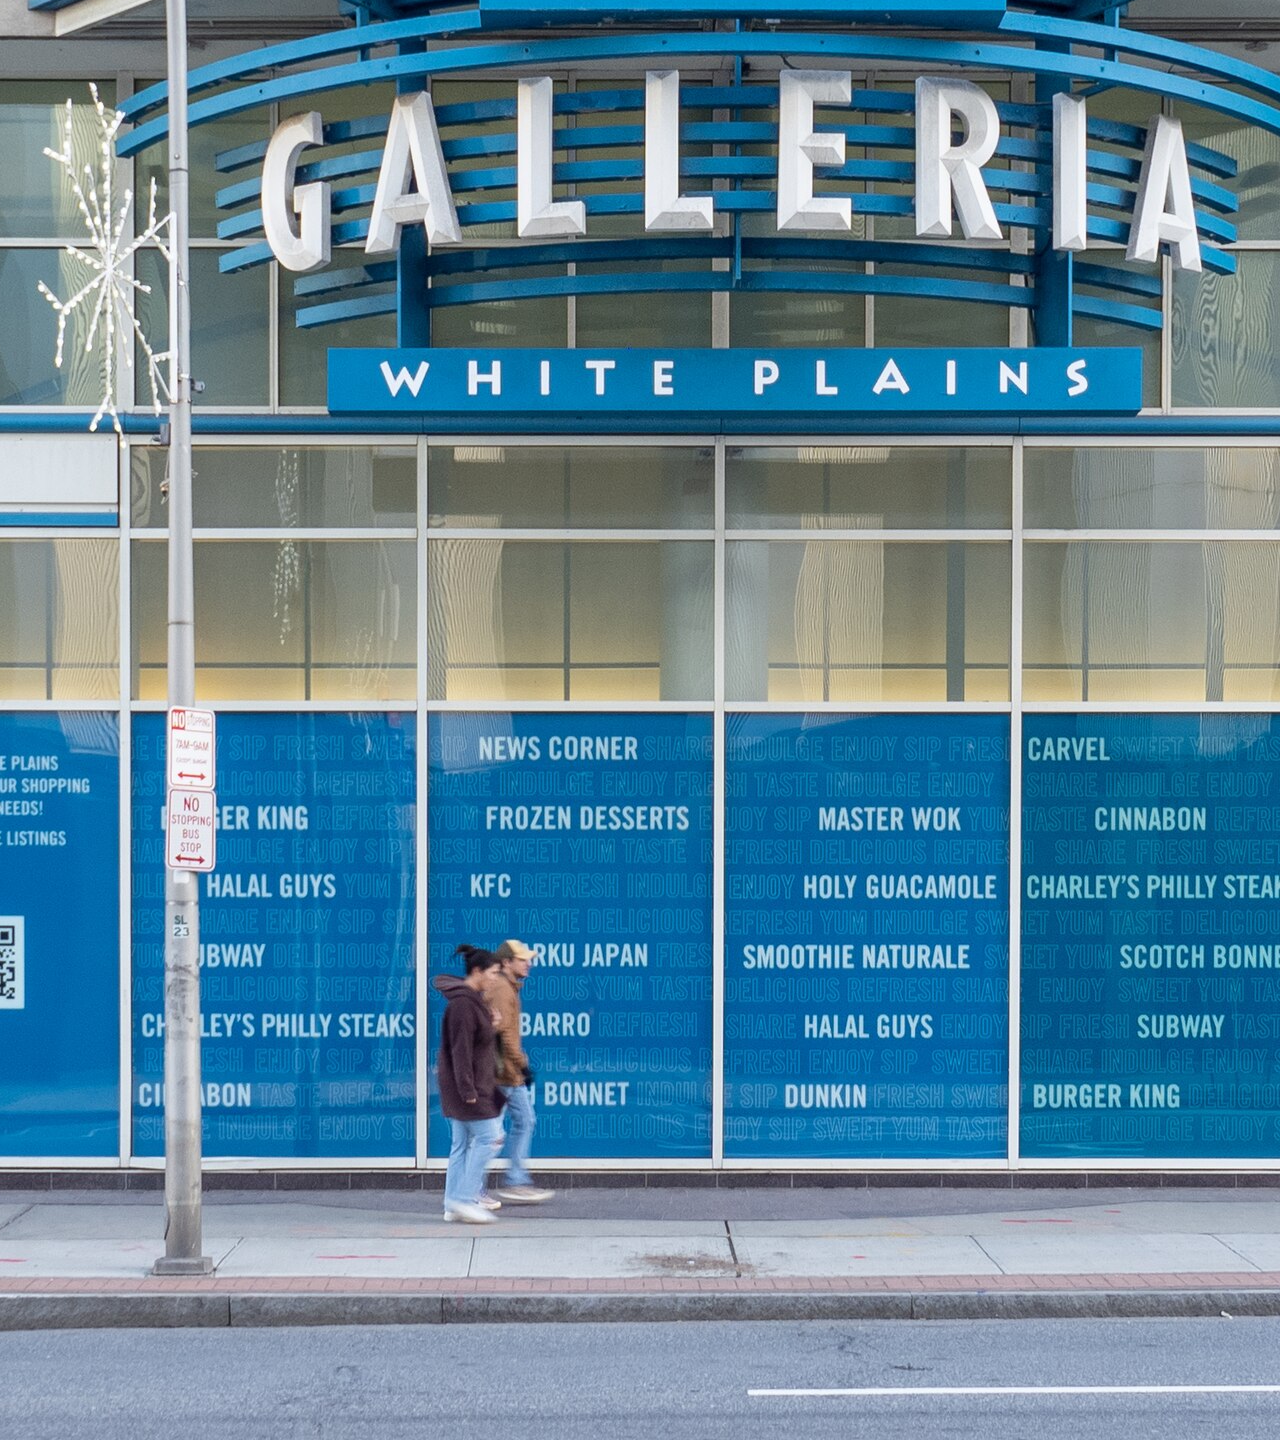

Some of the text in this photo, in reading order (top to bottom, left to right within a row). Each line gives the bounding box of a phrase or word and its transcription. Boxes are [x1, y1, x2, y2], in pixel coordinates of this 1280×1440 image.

[262, 69, 1202, 273] GALLERIA
[379, 359, 1089, 397] WHITE PLAINS
[173, 712, 185, 728] NO
[229, 735, 343, 760] SIP FRESH
[478, 736, 637, 761] NEWS CORNER
[832, 736, 941, 761] ENJOY SIP
[1029, 737, 1110, 761] CARVEL
[11, 755, 58, 771] PLAINS
[21, 778, 90, 793] SHOPPING
[499, 771, 667, 796] INDULGE ENJOY
[755, 772, 994, 797] TASTE INDULGE ENJOY
[1027, 772, 1273, 797] SHARE INDULGE ENJOY
[183, 797, 200, 812] NO
[171, 814, 212, 827] STOPPING
[258, 806, 308, 830] KING
[431, 806, 478, 830] YUM
[487, 806, 689, 830] FROZEN DESSERTS
[774, 806, 811, 832] SIP
[819, 807, 960, 831] MASTER WOK
[1095, 807, 1206, 831] CINNABON
[6, 830, 66, 846] LISTINGS
[182, 828, 200, 839] BUS
[180, 842, 202, 853] STOP
[292, 838, 359, 863] ENJOY
[488, 838, 686, 863] SWEET YUM TASTE
[811, 840, 926, 864] DELICIOUS
[1055, 840, 1126, 864] SHARE
[1137, 840, 1206, 864] FRESH
[206, 873, 336, 898] HALAL GUYS
[343, 873, 390, 898] YUM
[471, 874, 510, 897] KFC
[520, 873, 619, 898] REFRESH
[729, 874, 795, 899] ENJOY
[804, 875, 996, 899] HOLY GUACAMOLE
[1027, 875, 1139, 899] CHARLEY'S
[1147, 875, 1216, 898] PHILLY
[174, 915, 188, 925] SL
[174, 926, 190, 937] 23
[266, 909, 375, 933] ENJOY SIP
[462, 909, 703, 933] YUM TASTE DELICIOUS
[821, 910, 967, 935] YUM INDULGE
[1055, 910, 1103, 935] YUM
[1110, 910, 1173, 935] TASTE
[273, 943, 389, 968] DELICIOUS
[583, 944, 647, 967] JAPAN
[744, 945, 970, 969] SMOOTHIE NATURALE
[1065, 944, 1112, 969] YUM
[1120, 945, 1204, 968] SCOTCH
[594, 976, 643, 1001] YUM
[726, 977, 945, 1002] DELICIOUS REFRESH
[1039, 978, 1244, 1002] ENJOY SWEET YUM
[262, 1014, 331, 1038] PHILLY
[338, 1013, 416, 1038] STEAKS
[519, 1012, 590, 1037] BARRO
[598, 1012, 698, 1037] REFRESH
[726, 1014, 796, 1039] SHARE
[805, 1014, 933, 1038] HALAL GUYS
[941, 1014, 1007, 1039] ENJOY
[1021, 1014, 1130, 1039] SIP FRESH
[1138, 1015, 1224, 1038] SUBWAY
[255, 1048, 363, 1073] ENJOY SIP
[575, 1047, 691, 1072] DELICIOUS
[809, 1049, 1005, 1074] ENJOY SIP SWEET
[1022, 1049, 1267, 1073] SHARE INDULGE ENJOY
[545, 1082, 629, 1105] BONNET
[740, 1084, 777, 1108] SIP
[785, 1084, 866, 1108] DUNKIN
[874, 1084, 944, 1108] FRESH
[1034, 1084, 1179, 1108] BURGER KING
[570, 1114, 684, 1138] DELICIOUS
[1101, 1116, 1267, 1141] INDULGE ENJOY
